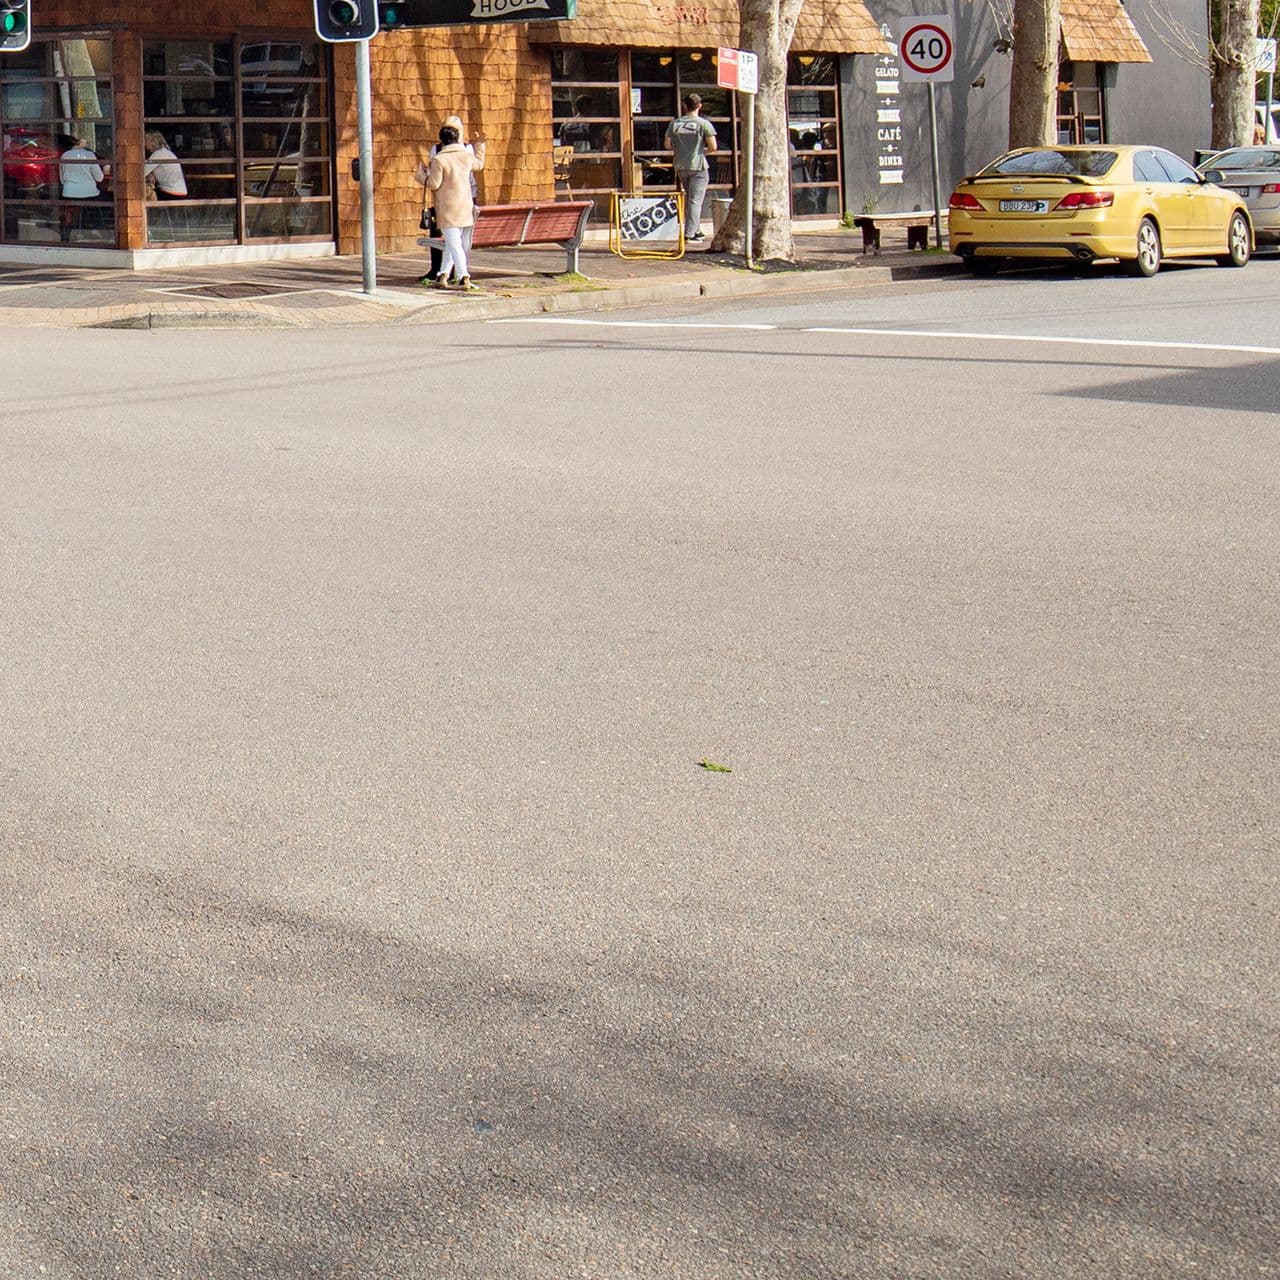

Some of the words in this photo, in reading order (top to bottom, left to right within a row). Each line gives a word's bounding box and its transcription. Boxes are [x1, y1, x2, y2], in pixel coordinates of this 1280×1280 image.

[910, 37, 944, 60] 40
[875, 67, 899, 77] GELATO
[877, 126, 902, 141] CAFÉ
[878, 155, 903, 167] DINER
[622, 200, 678, 240] HOOD
